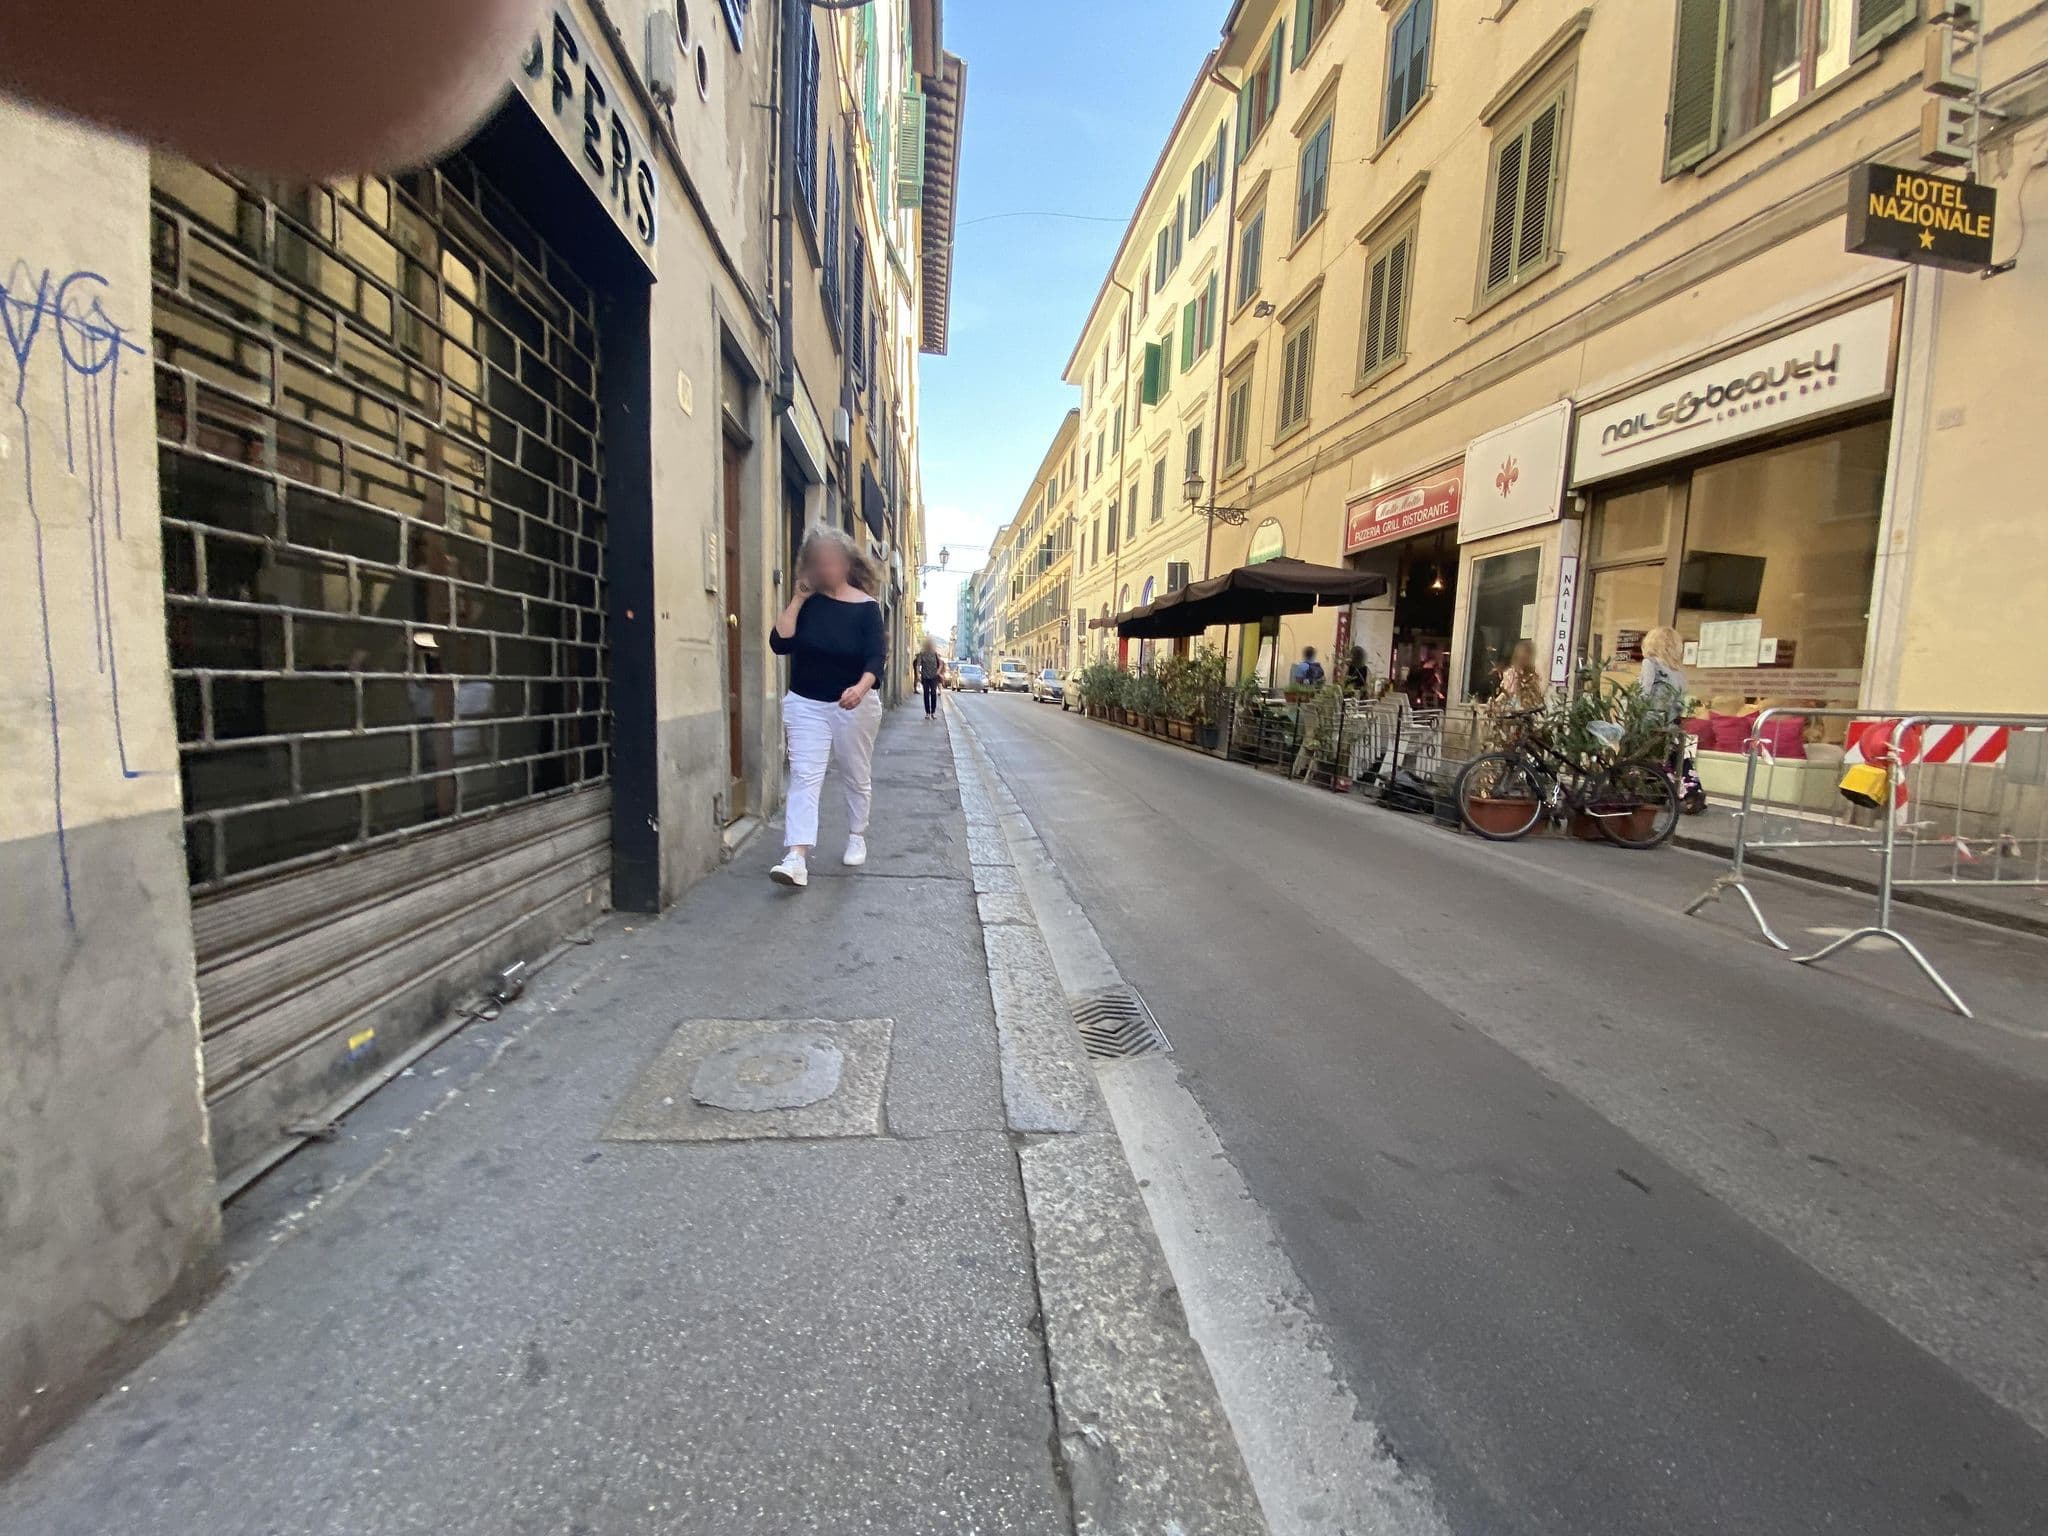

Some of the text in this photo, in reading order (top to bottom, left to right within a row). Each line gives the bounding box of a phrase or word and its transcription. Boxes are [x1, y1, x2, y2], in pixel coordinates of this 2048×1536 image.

[1896, 174, 1968, 210] HOTEL
[1869, 193, 1991, 238] NAZIONALE
[1716, 375, 1837, 421] LOUNGE BAR
[1355, 501, 1449, 542] PIZZERIA GRILL RISTORANTE
[1556, 574, 1572, 665] NAIL BAR
